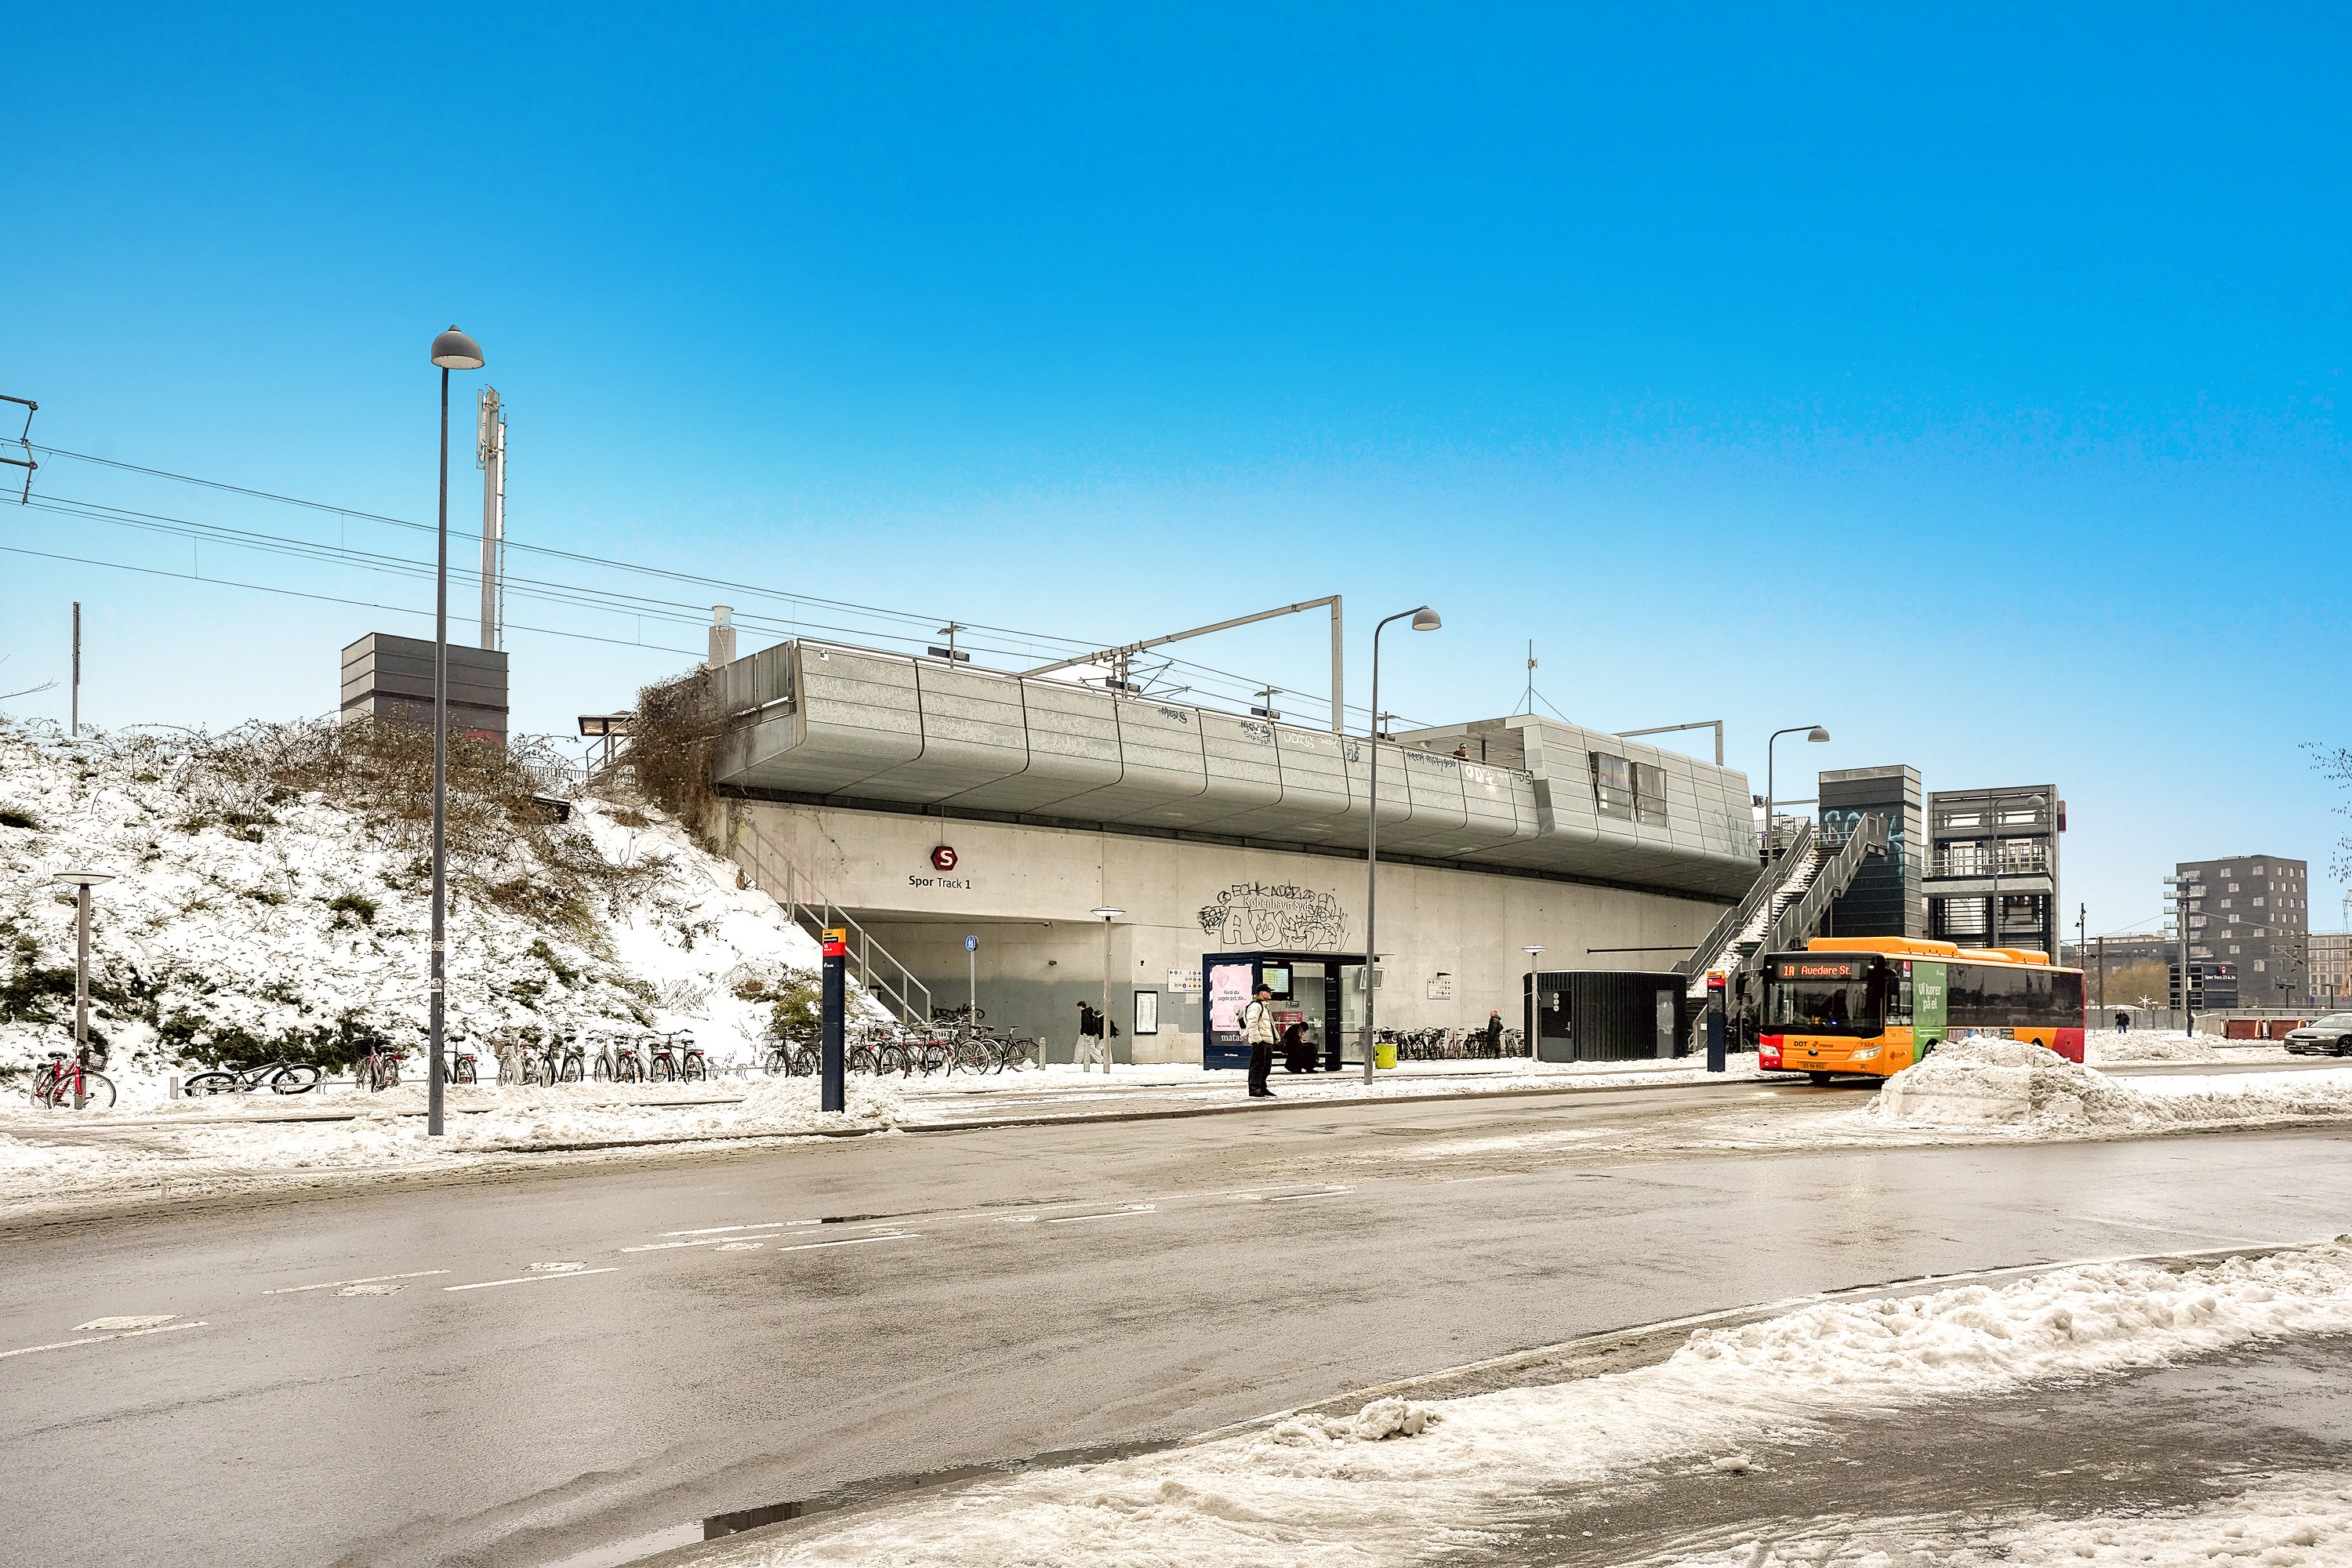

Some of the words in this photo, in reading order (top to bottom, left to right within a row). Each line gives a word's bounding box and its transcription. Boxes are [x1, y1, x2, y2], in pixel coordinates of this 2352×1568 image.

[940, 850, 953, 866] S
[909, 875, 934, 888] Spor
[937, 877, 962, 889] Track
[965, 880, 971, 889] 1
[1243, 896, 1292, 909] København
[1294, 899, 1309, 913] Syd
[1783, 965, 1796, 976] 1A
[1801, 965, 1838, 975] Avedøre
[1839, 965, 1852, 975] St.
[1918, 982, 1926, 996] Vi
[1926, 983, 1942, 996] kører
[1922, 996, 1930, 1011] på
[1931, 998, 1938, 1010] el
